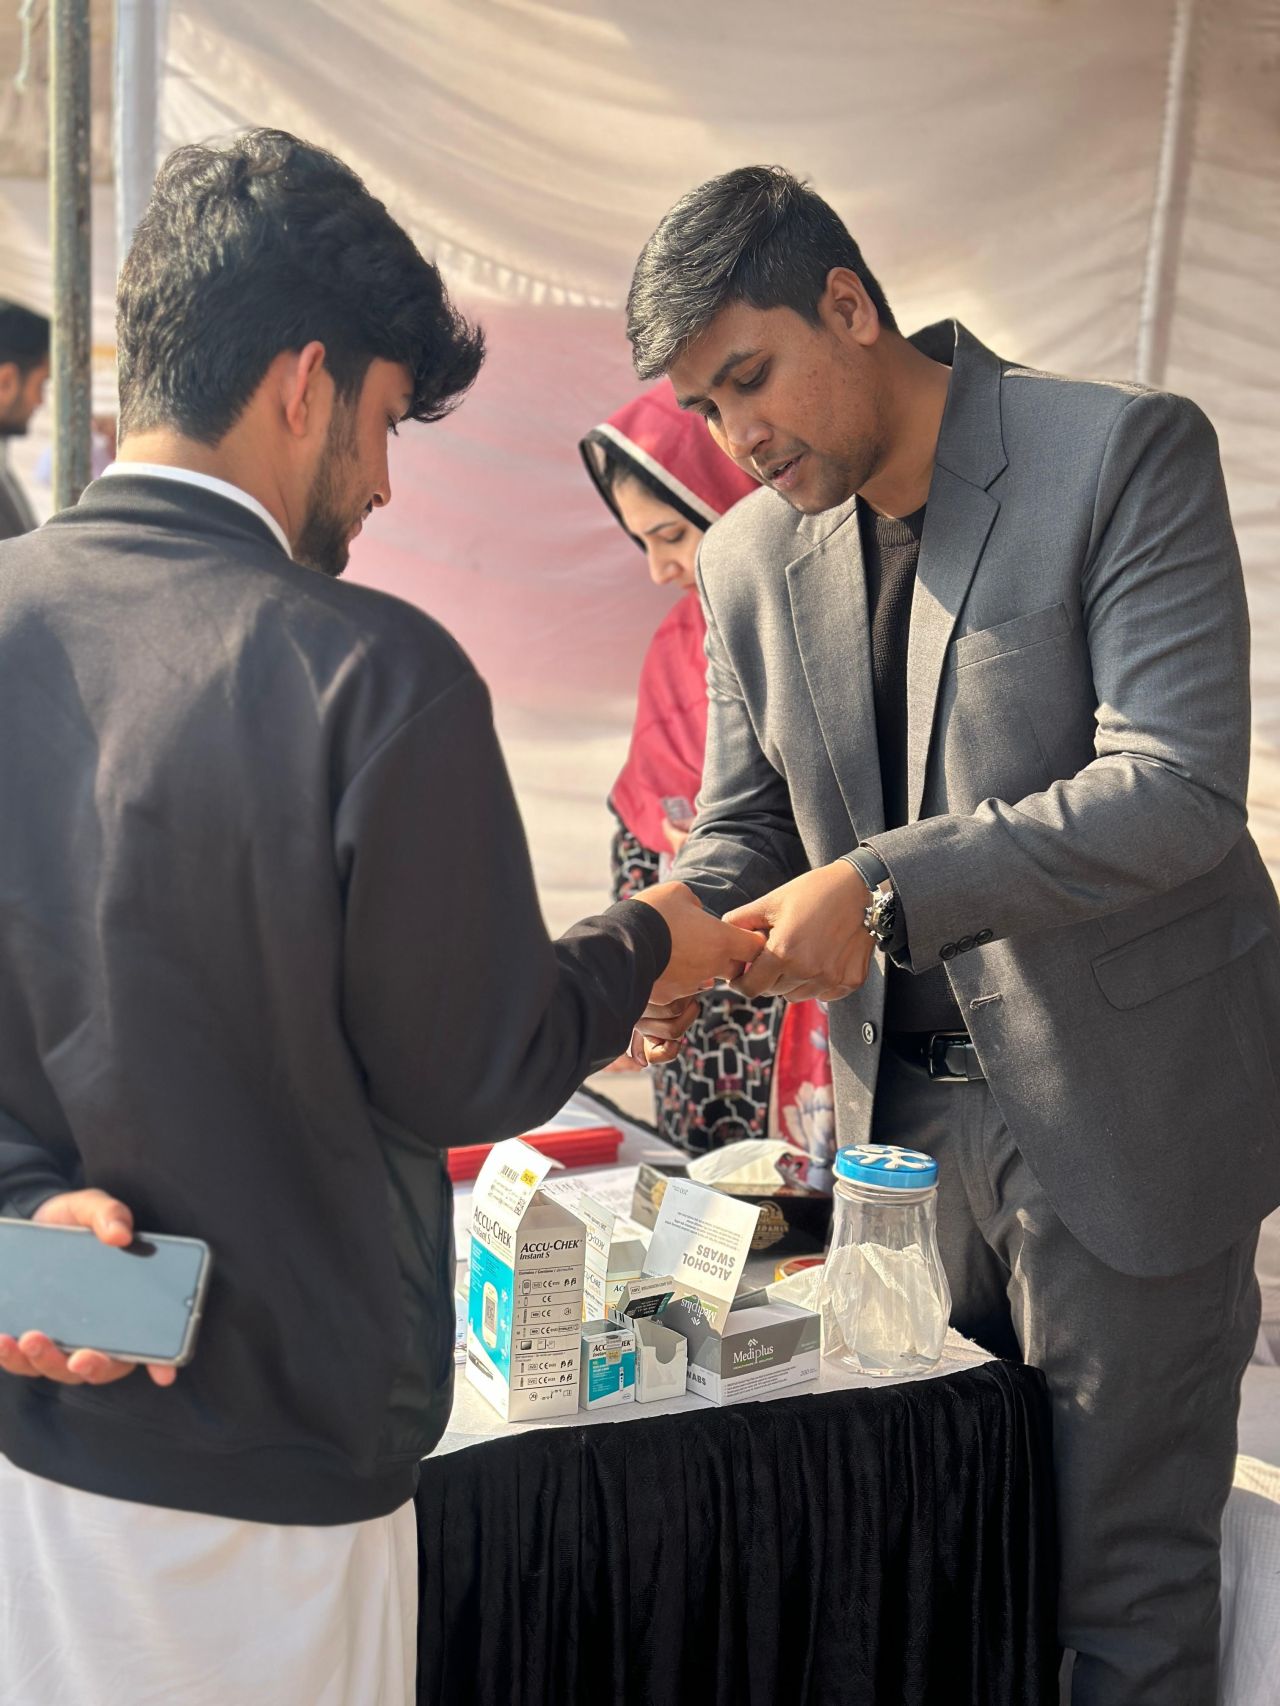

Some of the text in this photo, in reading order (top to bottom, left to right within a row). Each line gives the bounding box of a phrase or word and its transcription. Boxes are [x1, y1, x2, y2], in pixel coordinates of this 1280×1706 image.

[473, 1205, 512, 1249] ACCU-CHEK
[520, 1239, 580, 1253] ACCU-CHEK
[520, 1252, 544, 1260] Instant
[696, 1244, 736, 1268] SWABS
[682, 1253, 732, 1281] ALCOHOL
[680, 1297, 717, 1324] Mediplus
[733, 1344, 775, 1364] Mediplus
